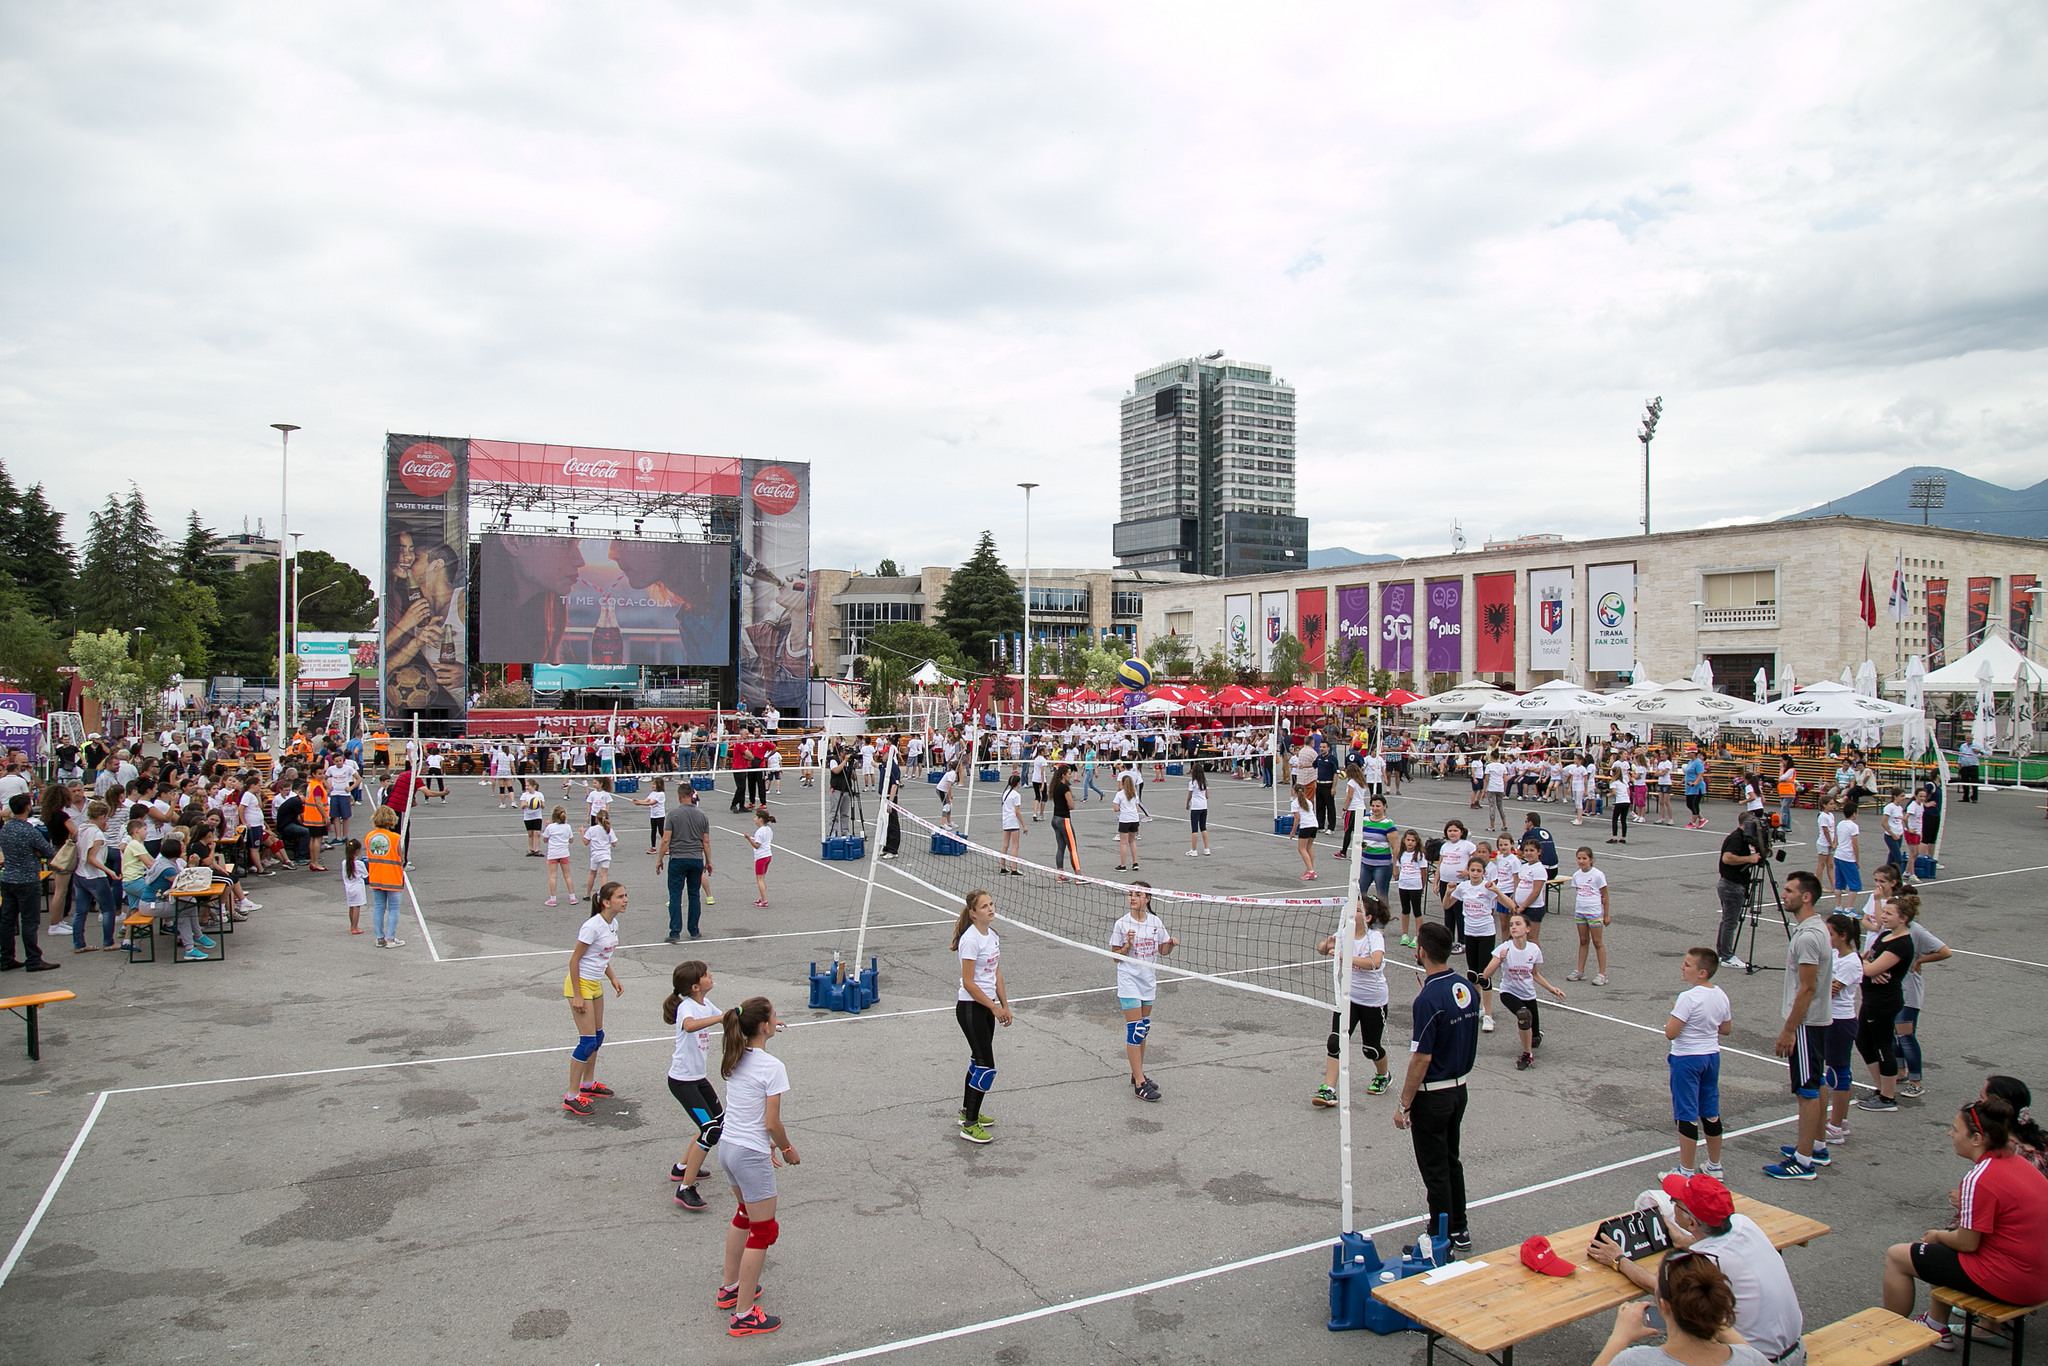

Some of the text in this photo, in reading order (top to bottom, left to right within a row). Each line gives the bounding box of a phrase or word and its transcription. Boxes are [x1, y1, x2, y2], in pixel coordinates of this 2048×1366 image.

[402, 460, 454, 478] Coca-Cola
[563, 457, 621, 479] Coca-Cola
[754, 482, 797, 499] Coca-Cola
[395, 502, 459, 512] TASTE THE FEELING
[560, 595, 673, 608] TI ME COCA-COLA
[1348, 624, 1368, 640] plus
[1382, 614, 1413, 641] 3G
[1438, 621, 1461, 639] plus
[1599, 629, 1624, 637] TIRANA
[1540, 638, 1562, 646] BASHKIA
[1610, 637, 1629, 645] ZONE
[535, 716, 577, 727] TASTE
[582, 716, 609, 727] THE
[6, 726, 29, 737] plus
[1613, 1216, 1667, 1257] 2 0 0 4
